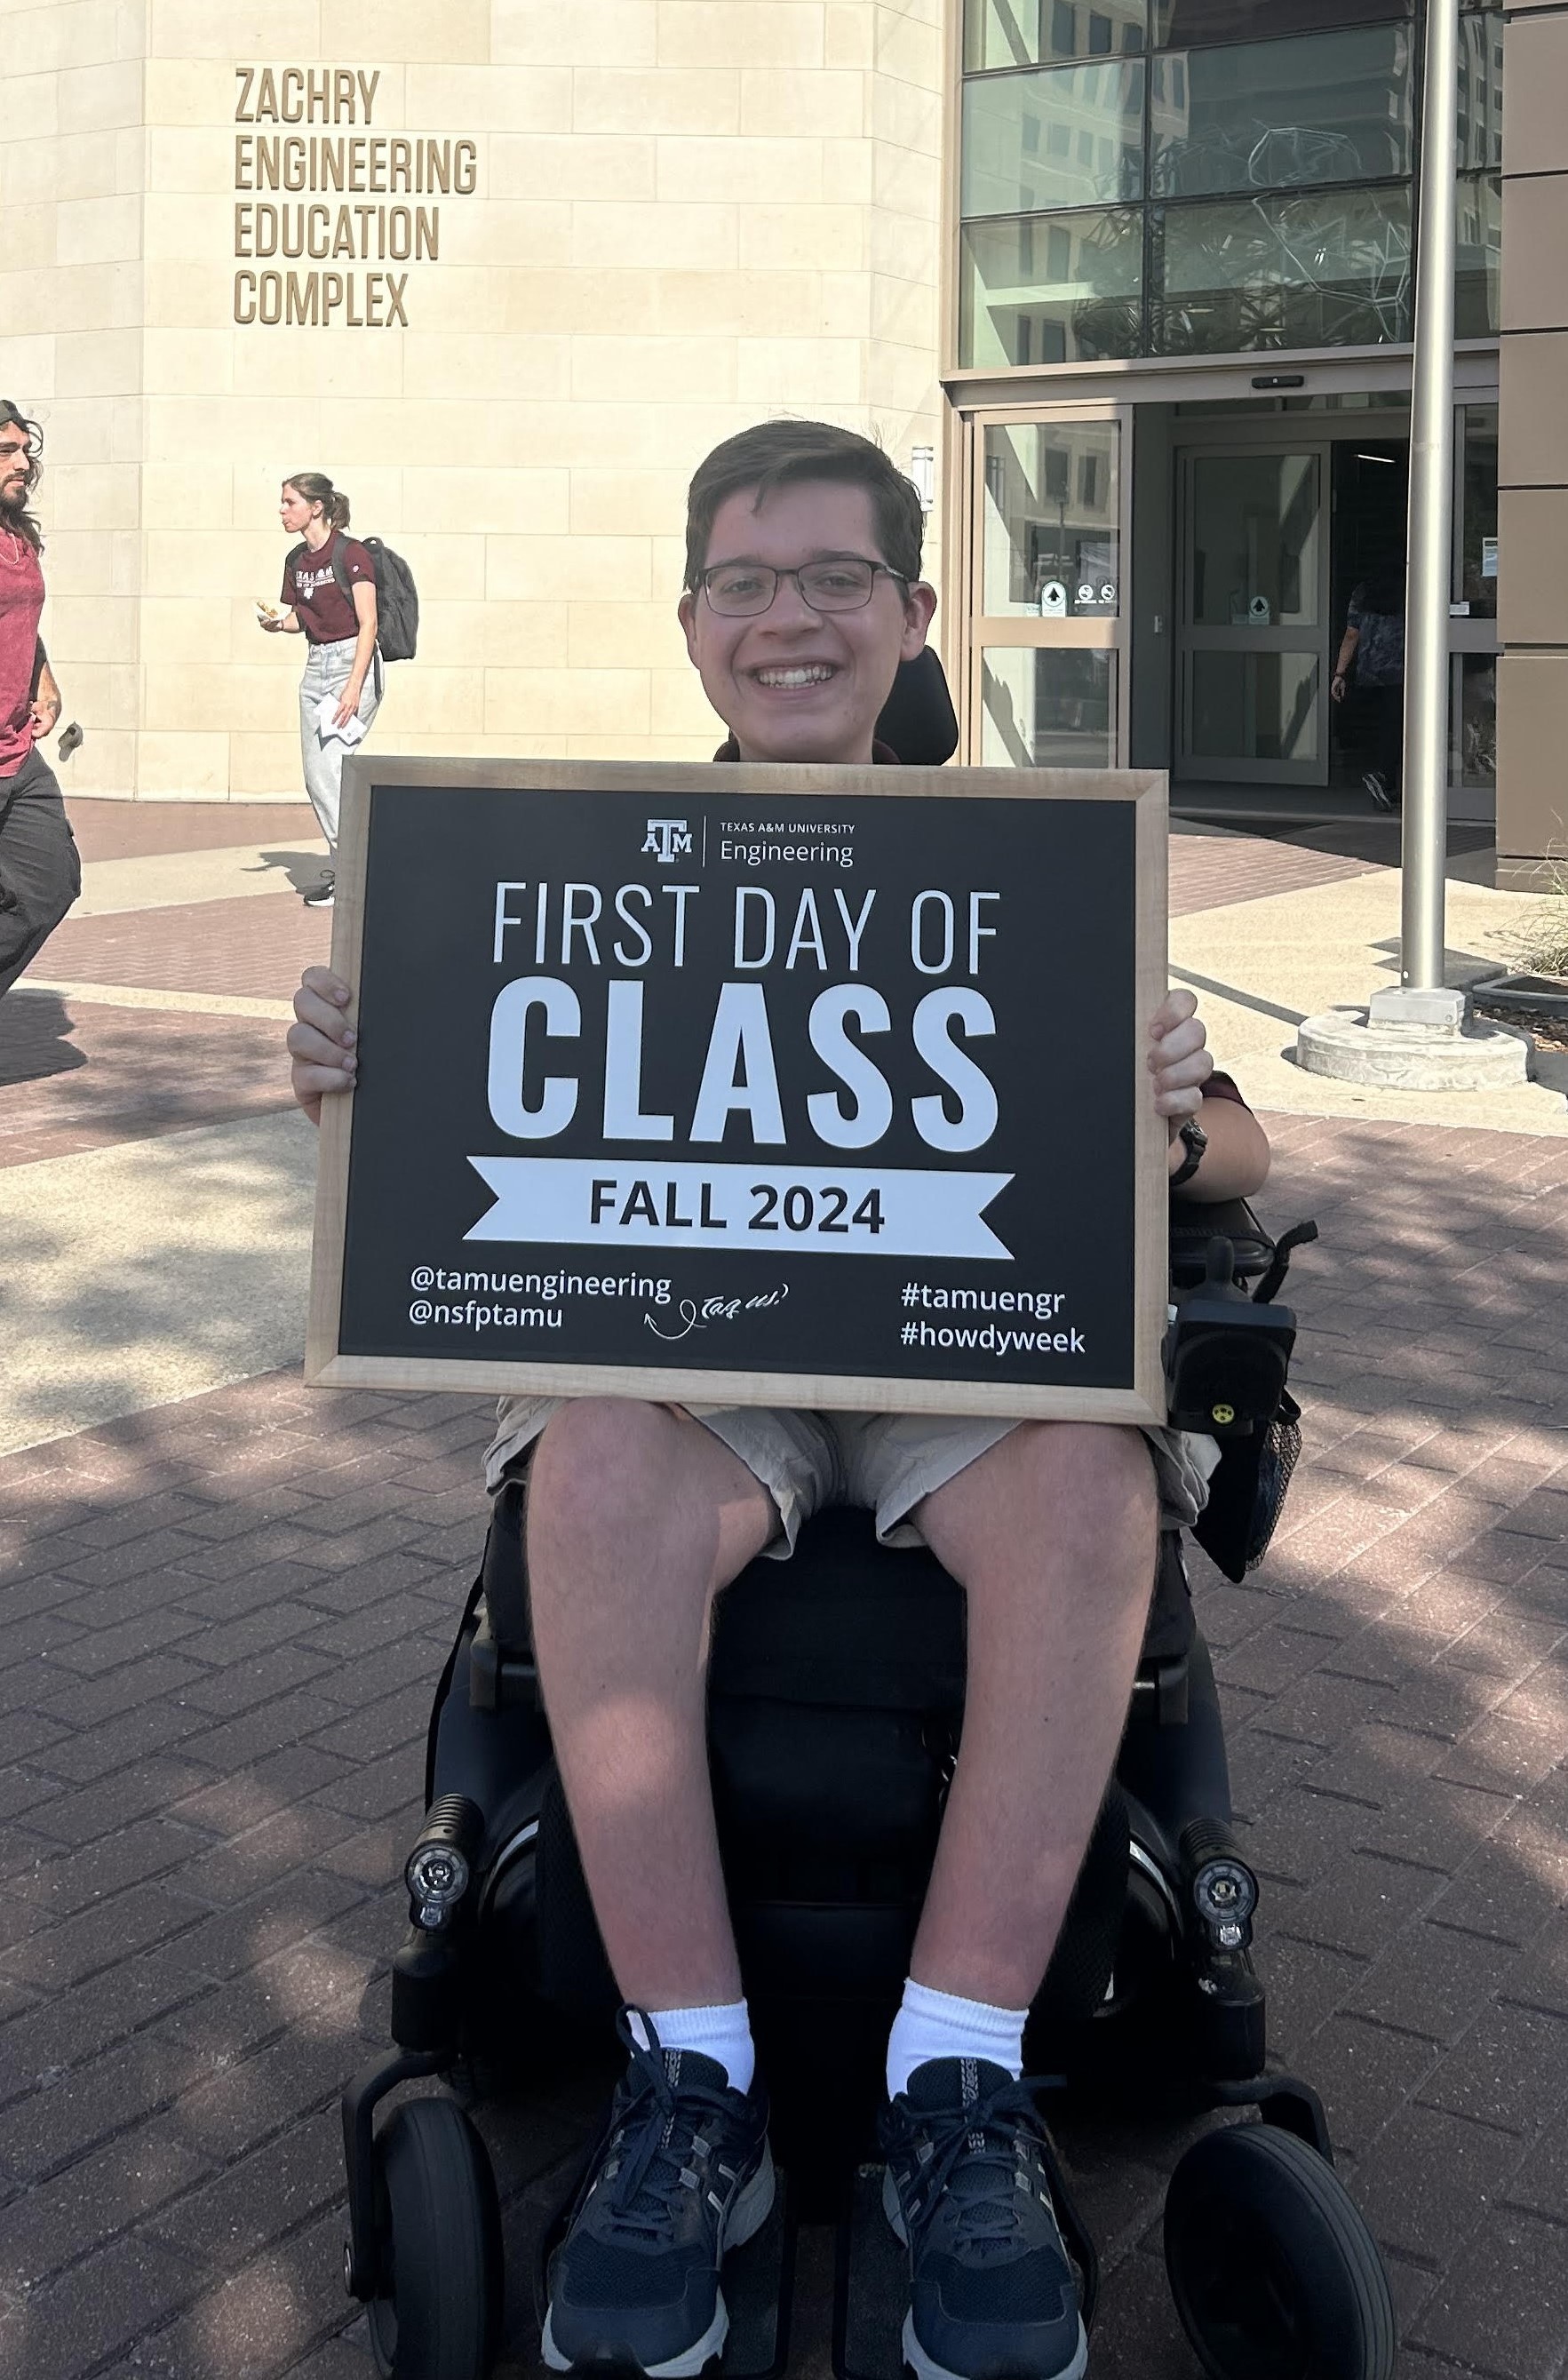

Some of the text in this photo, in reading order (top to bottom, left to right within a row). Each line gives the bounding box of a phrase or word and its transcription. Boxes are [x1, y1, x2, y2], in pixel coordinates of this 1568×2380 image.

[235, 68, 380, 124] ZACHRY
[235, 135, 476, 195] ENGINEERING
[235, 203, 439, 260] EDUCATION
[234, 270, 409, 327] COMPLEX
[720, 822, 856, 834] TEXAS A&M UNIVERSITY
[720, 840, 854, 868] Engineering
[493, 881, 1000, 975] FIRST DAY OF
[487, 975, 999, 1153] CLASS
[590, 1179, 886, 1234] FALL 2024
[410, 1265, 672, 1305] @tamuengineering
[901, 1282, 1066, 1320] #tamuengr
[409, 1299, 562, 1332] @nsfptamu
[900, 1320, 1086, 1357] #howdyweek
